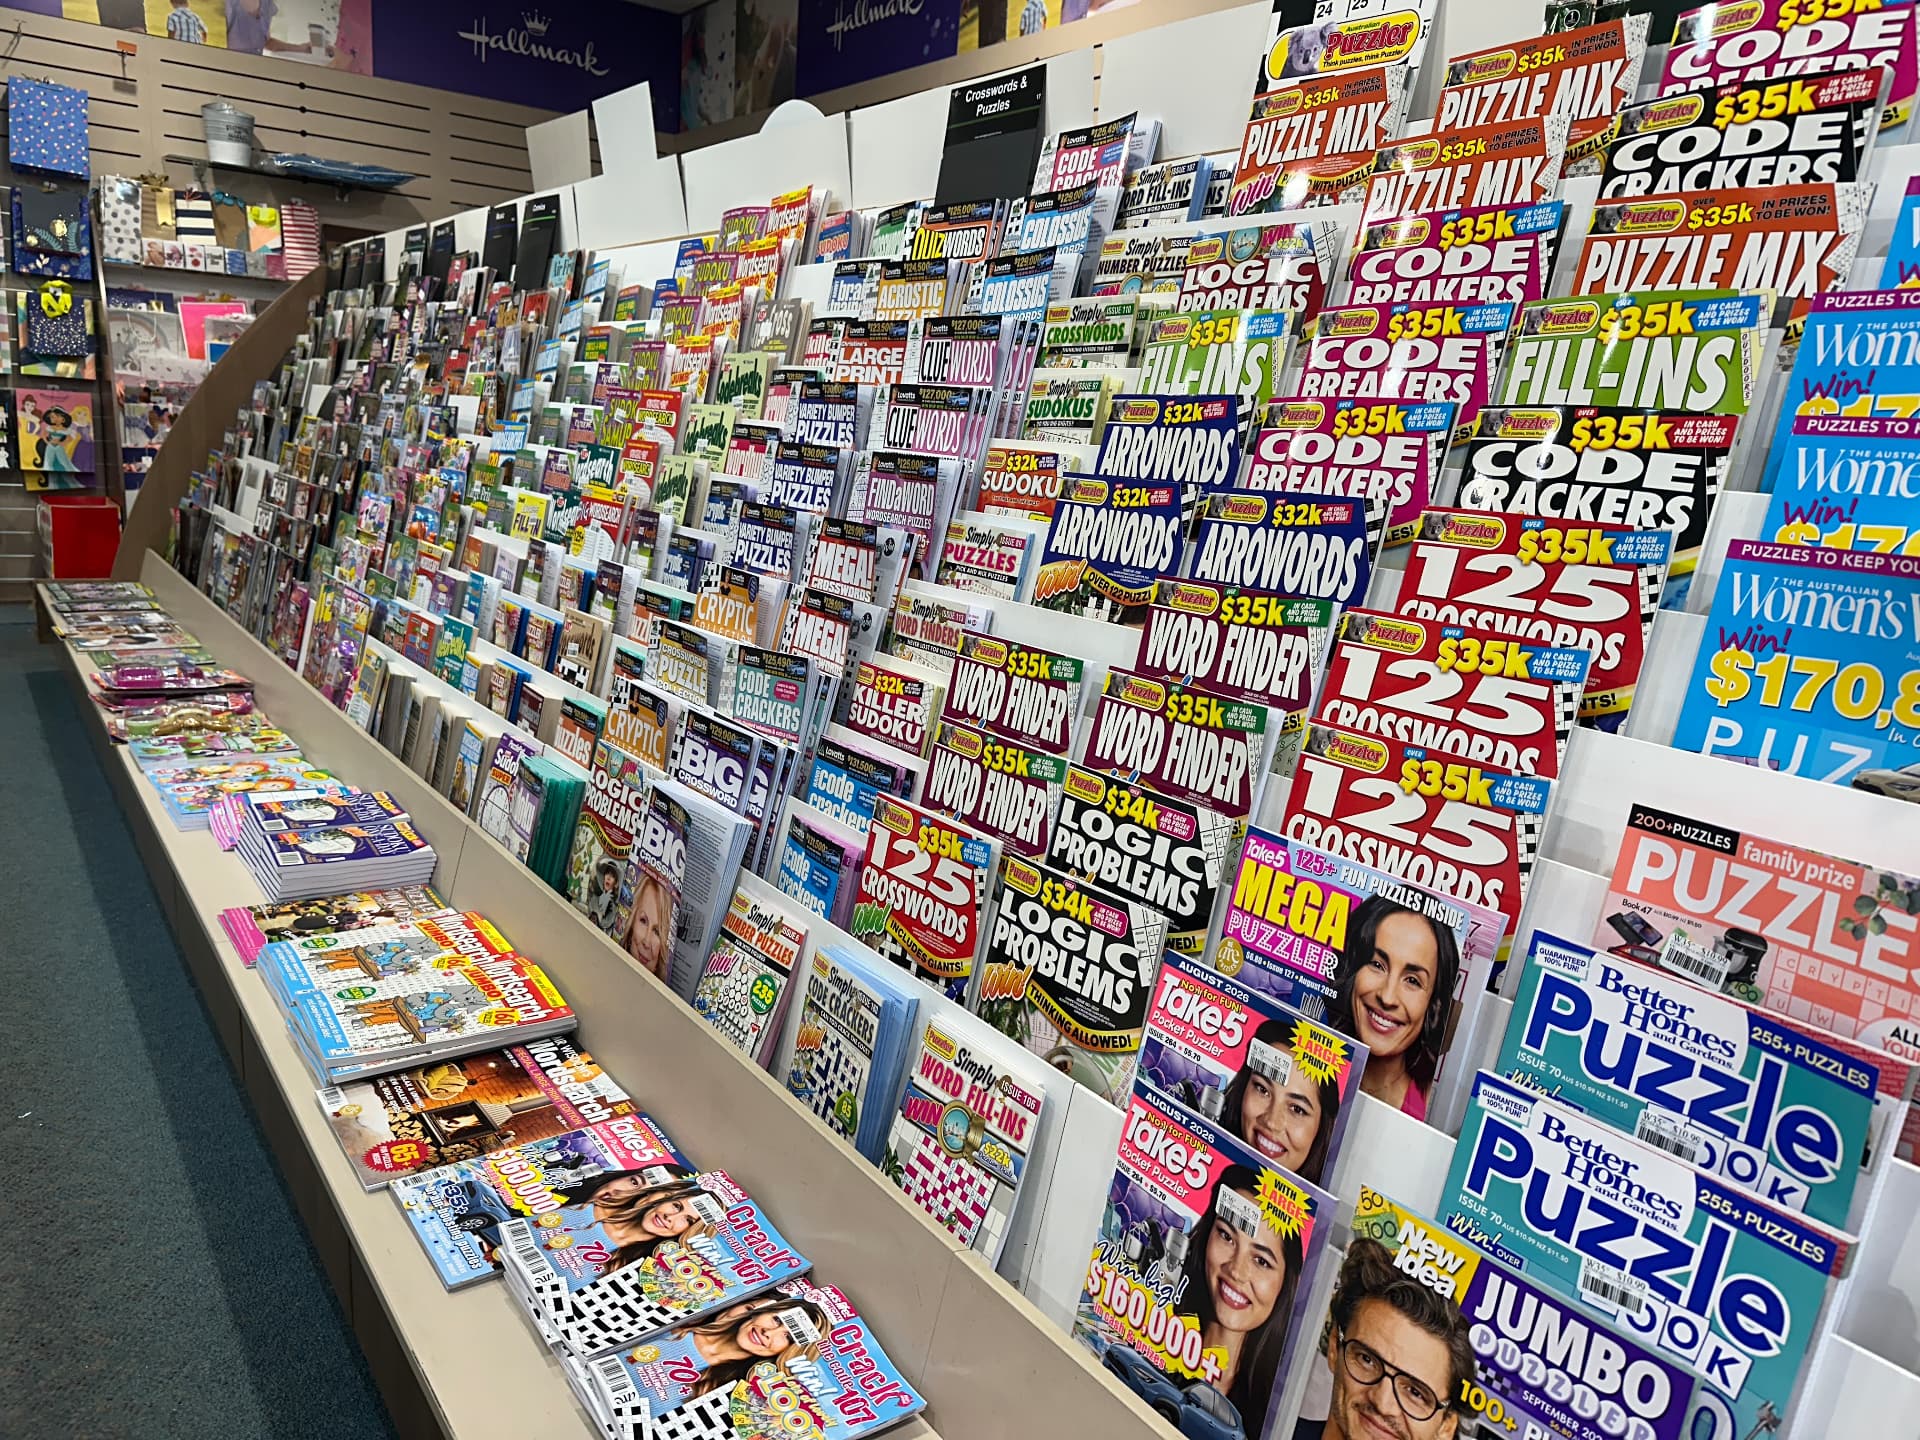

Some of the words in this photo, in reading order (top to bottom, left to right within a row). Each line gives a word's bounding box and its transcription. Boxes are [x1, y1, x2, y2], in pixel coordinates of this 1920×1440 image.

[1317, 4, 1332, 17] 24
[1346, 21, 1380, 32] Australian
[457, 15, 609, 76] Hallmark
[1323, 57, 1339, 68] Think
[1340, 55, 1363, 67] puzzles,
[1363, 52, 1379, 63] think
[1379, 48, 1404, 62] Puzzler
[1325, 21, 1414, 60] Puzzler
[1670, 10, 1911, 79] CODE
[965, 80, 1018, 102] Crosswords
[1020, 75, 1028, 89] &
[976, 99, 1010, 117] Puzzles
[1303, 87, 1340, 110] $35k
[1438, 73, 1551, 134] PUZZLE
[1555, 59, 1624, 120] MIX
[1713, 81, 1817, 126] $35k
[1242, 114, 1324, 169] PUZZLE
[1324, 101, 1386, 155] MIX
[1644, 103, 1698, 126] Puzzler
[1612, 112, 1850, 171] CODE
[1602, 153, 1843, 199] CRACKERS
[1687, 203, 1755, 231] $35k
[1756, 211, 1770, 220] TO
[1771, 209, 1789, 219] BE
[1791, 205, 1831, 217] WON!
[1762, 200, 1774, 208] IN
[1776, 194, 1827, 208] PRIZES
[913, 227, 985, 260] QUIZWORDS
[1097, 260, 1140, 274] NUMBER
[1141, 255, 1187, 272] PUZZLES
[1581, 233, 1731, 296] PUZZLE
[1730, 231, 1836, 298] MIX
[1181, 256, 1314, 293] LOGIC
[1070, 302, 1102, 322] Simply
[1597, 301, 1698, 343] $35k
[1824, 296, 1897, 309] PUZZLES
[1046, 322, 1125, 344] CROSSWORDS
[1311, 337, 1484, 370] CODE
[836, 363, 902, 384] PRINT
[844, 346, 904, 366] LARGE
[1140, 343, 1269, 397] FILL-INS
[1504, 334, 1735, 412] FILL-INS
[1741, 332, 1752, 400] OUTDOORS
[1027, 397, 1095, 420] SUDOKUS
[1300, 371, 1474, 405] BREAKERS
[800, 403, 825, 420] VARIETY
[826, 404, 855, 420] BUMPER
[1333, 404, 1408, 439] $35k
[1674, 427, 1693, 436] AND
[1695, 426, 1728, 436] PRIZES
[1684, 420, 1696, 428] IN
[1698, 419, 1720, 428] CASH
[1098, 425, 1240, 486] ARROWORDS
[1260, 432, 1425, 470] CODE
[1674, 435, 1685, 443] TO
[1687, 435, 1697, 444] BE
[1699, 434, 1724, 444] WON!
[981, 470, 1058, 499] SUDOKU
[1252, 464, 1416, 505] BREAKERS
[1472, 442, 1702, 493] CODE
[1461, 478, 1694, 535] CRACKERS
[1197, 522, 1362, 602] ARROWORDS
[1741, 544, 1810, 563] PUZZLES
[1814, 552, 1838, 564] TO
[1842, 555, 1885, 570] KEEP
[1415, 545, 1635, 623] 125
[1782, 578, 1804, 588] THE
[1807, 580, 1879, 597] AUSTRALIAN
[697, 594, 757, 633] CRYPTIC
[1732, 571, 1906, 644] Women's
[796, 612, 849, 661] MEGA!
[1368, 623, 1420, 643] Puzzler
[1718, 624, 1793, 653] Win!
[1146, 609, 1221, 678] WORD
[1220, 626, 1308, 701] FINDER
[739, 668, 772, 694] CODE
[1338, 650, 1550, 736] 125
[736, 692, 800, 731] CRACKERS
[849, 703, 922, 744] SUDOKU
[854, 682, 924, 724] KILLER
[1165, 693, 1225, 729] $35k
[680, 737, 744, 802] BIG
[1094, 699, 1161, 775] WORD
[1162, 720, 1248, 807] FINDER
[678, 770, 738, 808] CROSSWORD
[1398, 758, 1496, 807] $35k
[1105, 786, 1162, 832] $34k
[1296, 757, 1512, 867] 125
[1061, 797, 1207, 879] LOGIC
[1245, 837, 1288, 867] Take5
[1633, 812, 1732, 850] 200+PUZZLES
[870, 823, 973, 905] 125
[1052, 827, 1200, 918] PROBLEMS
[1286, 813, 1503, 912] CROSSWORDS
[1742, 841, 1804, 874] family
[1804, 863, 1855, 890] prize
[861, 865, 968, 943] CROSSWORDS
[1233, 857, 1353, 950] MEGA
[1295, 849, 1337, 877] 125+
[1339, 865, 1368, 890] FUN
[1368, 877, 1423, 914] PUZZLES
[1422, 898, 1465, 932] INSIDE
[1622, 898, 1641, 911] Book
[1641, 904, 1653, 915] 47
[890, 919, 927, 962] INCLUDES
[927, 956, 964, 972] GIANTS!
[999, 894, 1145, 987] LOGIC
[1227, 910, 1340, 981] PUZZLER
[1539, 947, 1587, 967] GUARANTEED
[464, 968, 502, 998] JUMBO
[992, 920, 1134, 1015] PROBLEMS
[1179, 961, 1223, 988] AUGUST
[1225, 984, 1249, 1003] 2026
[1283, 967, 1294, 979] 127
[1299, 975, 1318, 991] August
[1318, 984, 1338, 999] 2026
[1157, 972, 1248, 1047] Take5
[1596, 965, 1694, 1021] Better
[1071, 1020, 1133, 1052] ALLOWED!
[1152, 1011, 1185, 1035] Pocket
[1186, 1030, 1224, 1057] Puzzler
[1296, 1033, 1341, 1065] LARGE
[1309, 1028, 1333, 1048] WITH
[1620, 1001, 1737, 1059] Homes
[954, 1048, 997, 1091] Simply
[1184, 1047, 1200, 1062] $5.70
[1302, 1051, 1329, 1074] PRINT
[1517, 1051, 1546, 1071] ISSUE
[1548, 1065, 1561, 1078] 70
[1680, 1040, 1735, 1071] Gardens.
[1751, 1026, 1793, 1058] 255+
[1794, 1047, 1871, 1090] PUZZLES
[526, 1041, 613, 1123] Wordsearch
[920, 1052, 964, 1099] WORD
[966, 1085, 1028, 1143] FILL-INS
[1525, 973, 1842, 1181] Puzzle
[1023, 1093, 1037, 1110] 106
[1121, 1103, 1214, 1190] Take5
[1398, 1218, 1465, 1273] New
[1466, 1116, 1785, 1352] Puzzle
[1094, 1239, 1141, 1283] Win
[1144, 1260, 1189, 1309] big!
[1392, 1245, 1457, 1300] Idea
[1086, 1260, 1223, 1386] $160,000+
[830, 1324, 901, 1406] Crack
[1474, 1275, 1671, 1419] JUMBO
[833, 1389, 878, 1426] 107
